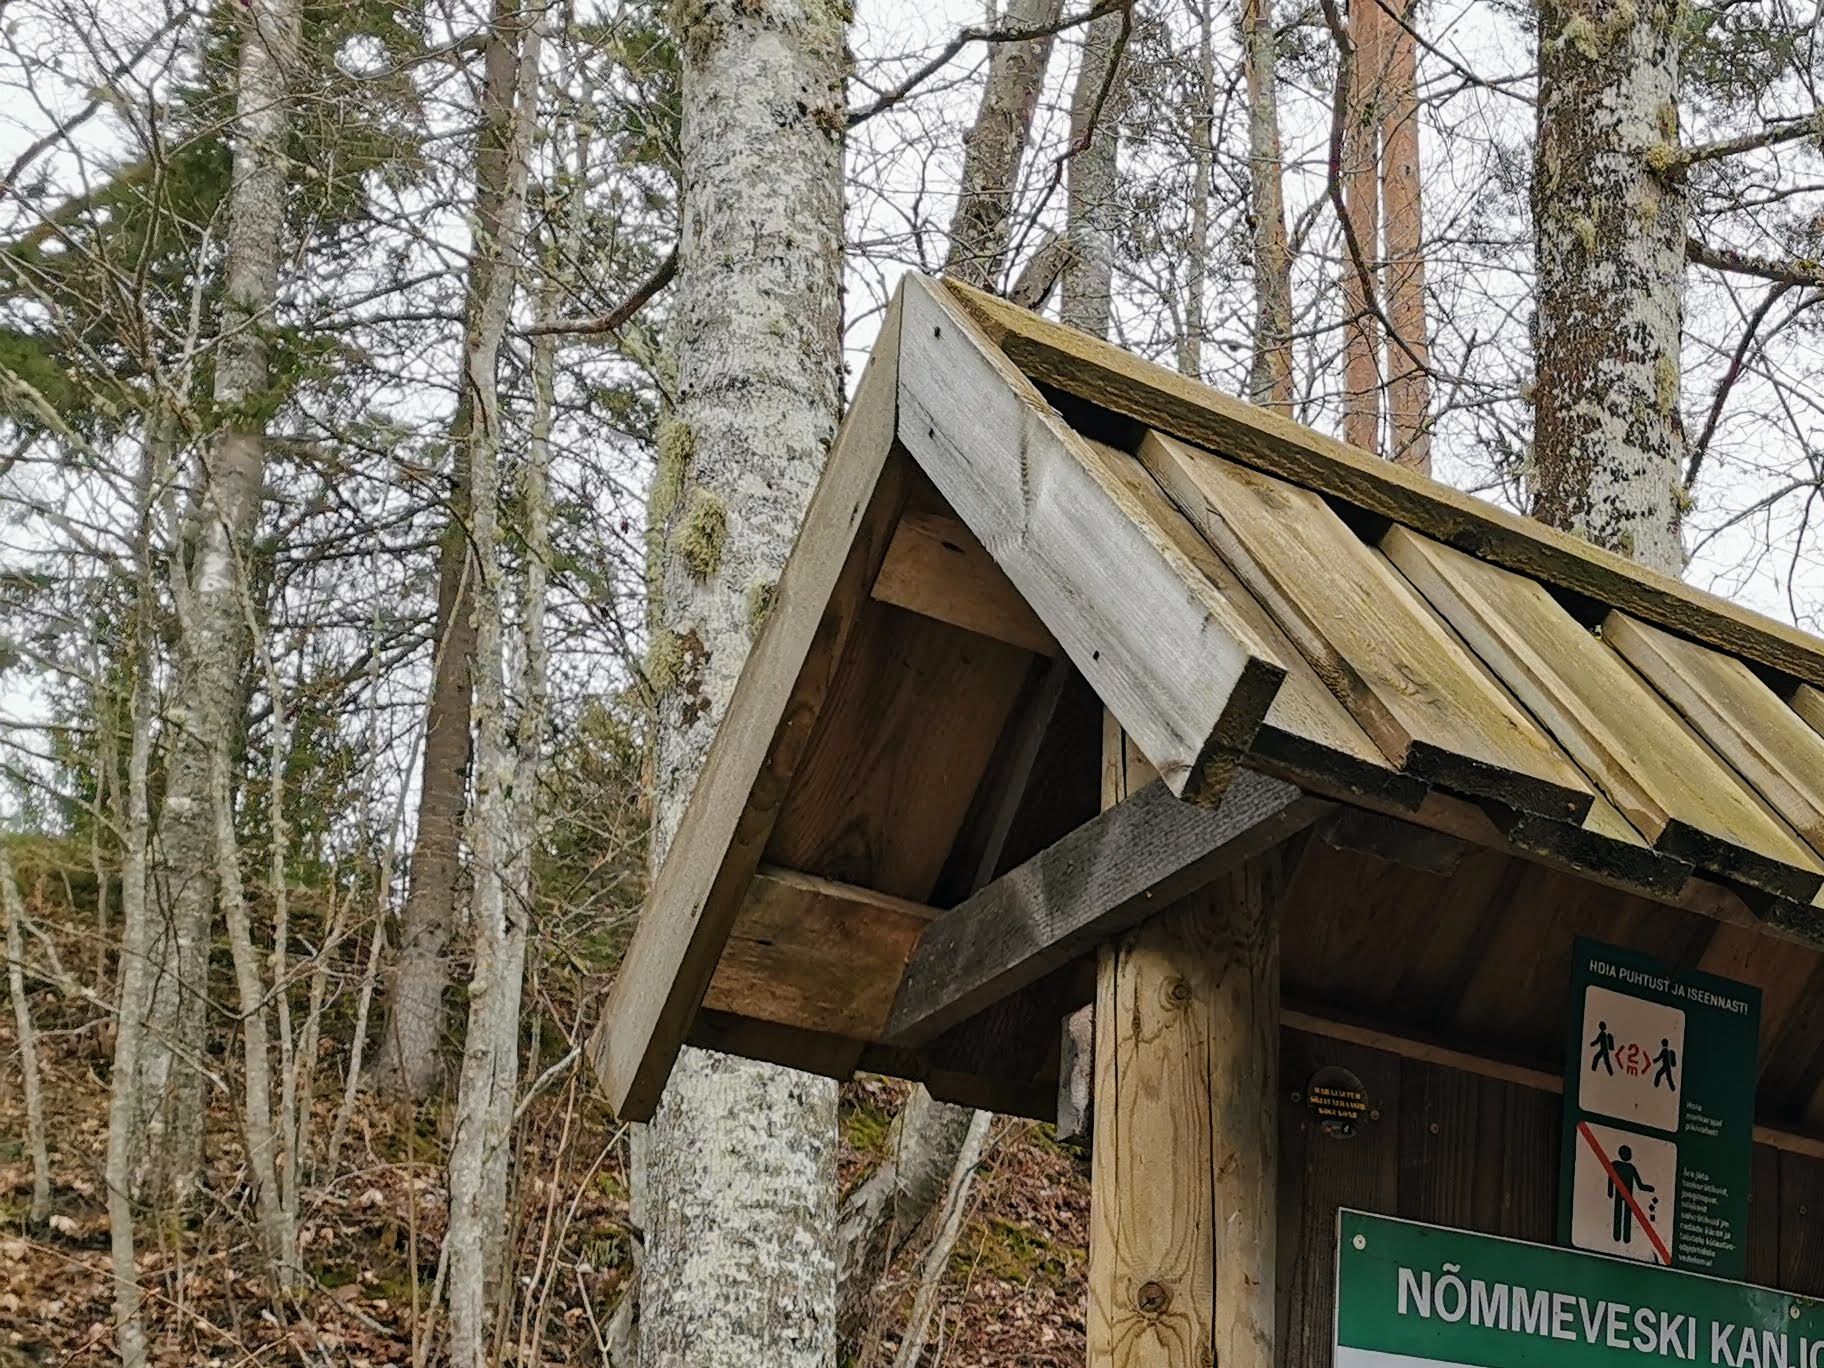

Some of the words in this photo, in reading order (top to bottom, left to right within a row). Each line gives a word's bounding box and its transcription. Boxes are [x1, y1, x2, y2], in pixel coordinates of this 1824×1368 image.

[1589, 959, 1616, 978] HOIA
[1619, 967, 1669, 992] PUHTUST
[1671, 984, 1685, 997] JA
[1397, 1262, 1697, 1361] NÕMMEVESKI
